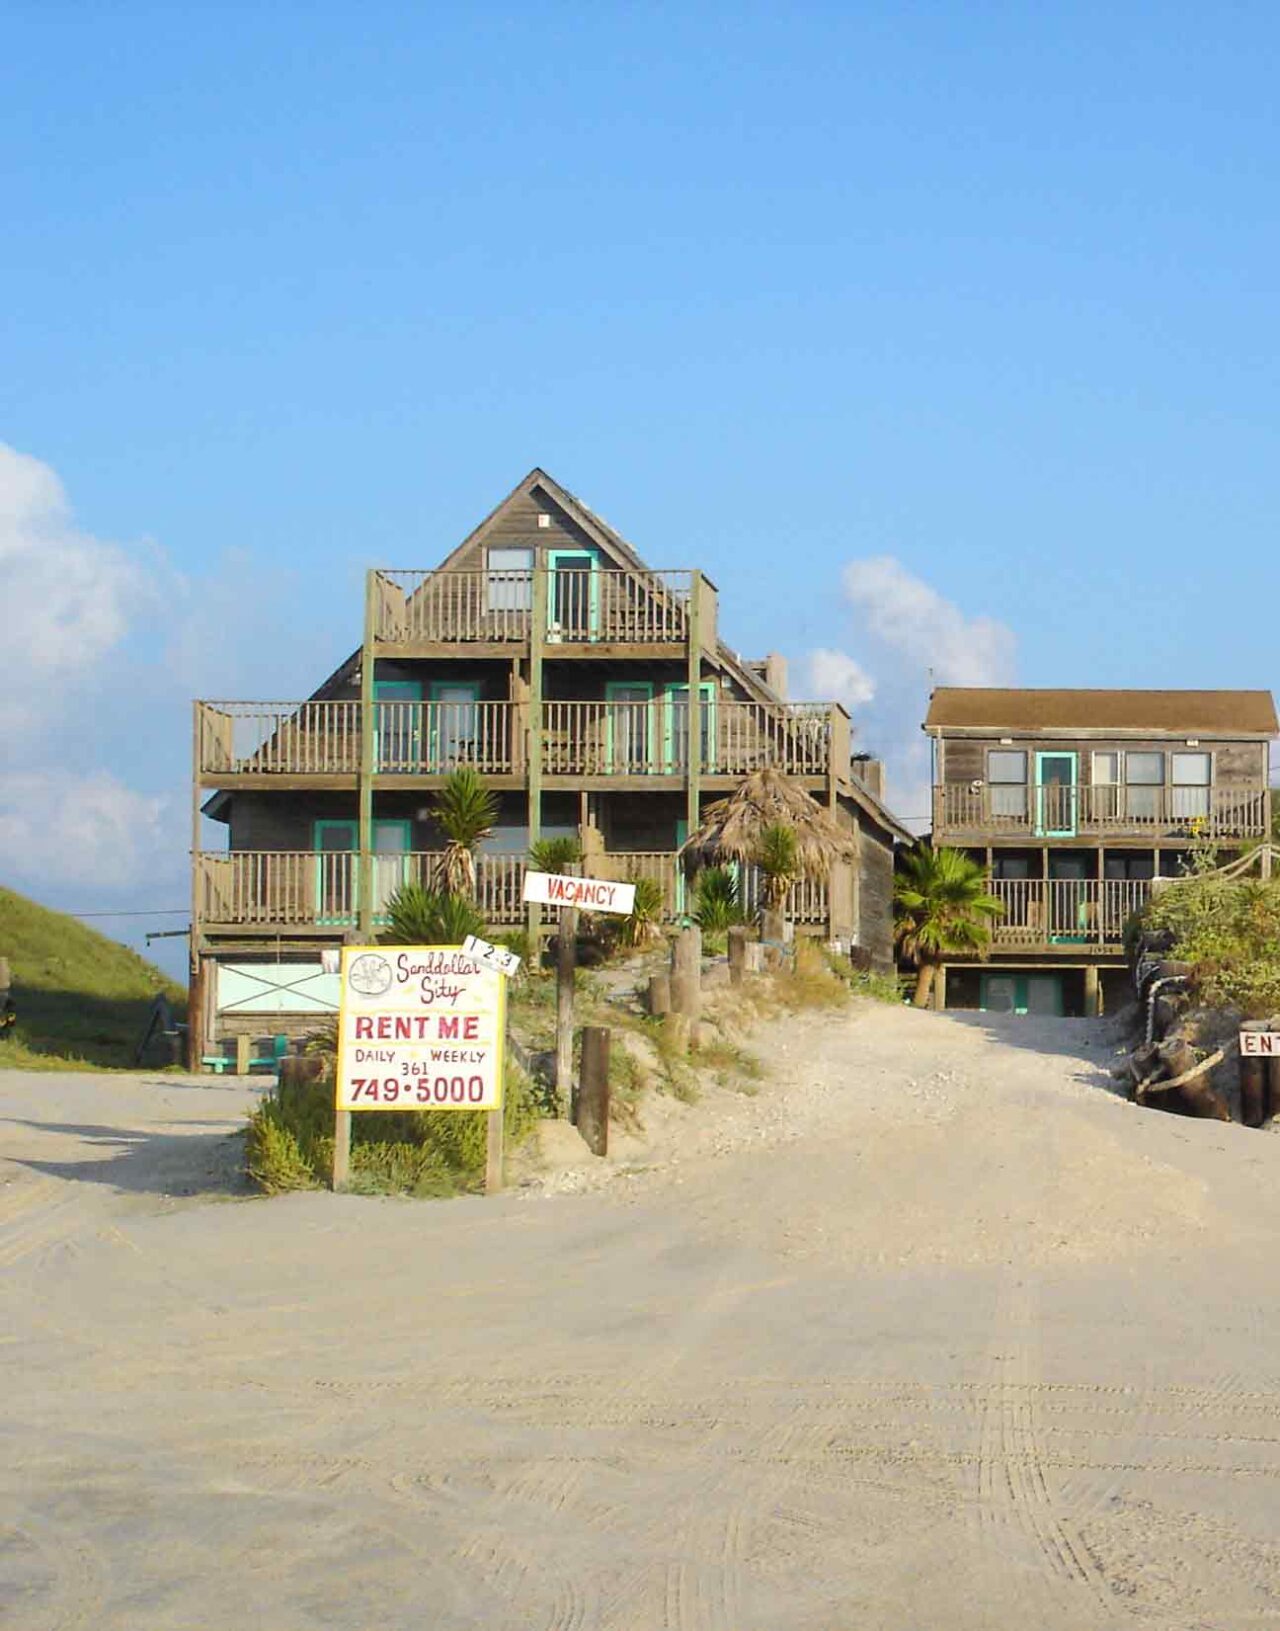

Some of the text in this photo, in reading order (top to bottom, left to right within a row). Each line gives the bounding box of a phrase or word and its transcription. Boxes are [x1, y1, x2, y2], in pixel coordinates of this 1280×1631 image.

[548, 878, 616, 906] VACANCY
[421, 976, 467, 1006] Sity
[355, 1016, 480, 1040] RENT ME
[355, 1049, 486, 1063] DAILY WEEKLY
[401, 1062, 429, 1076] 361
